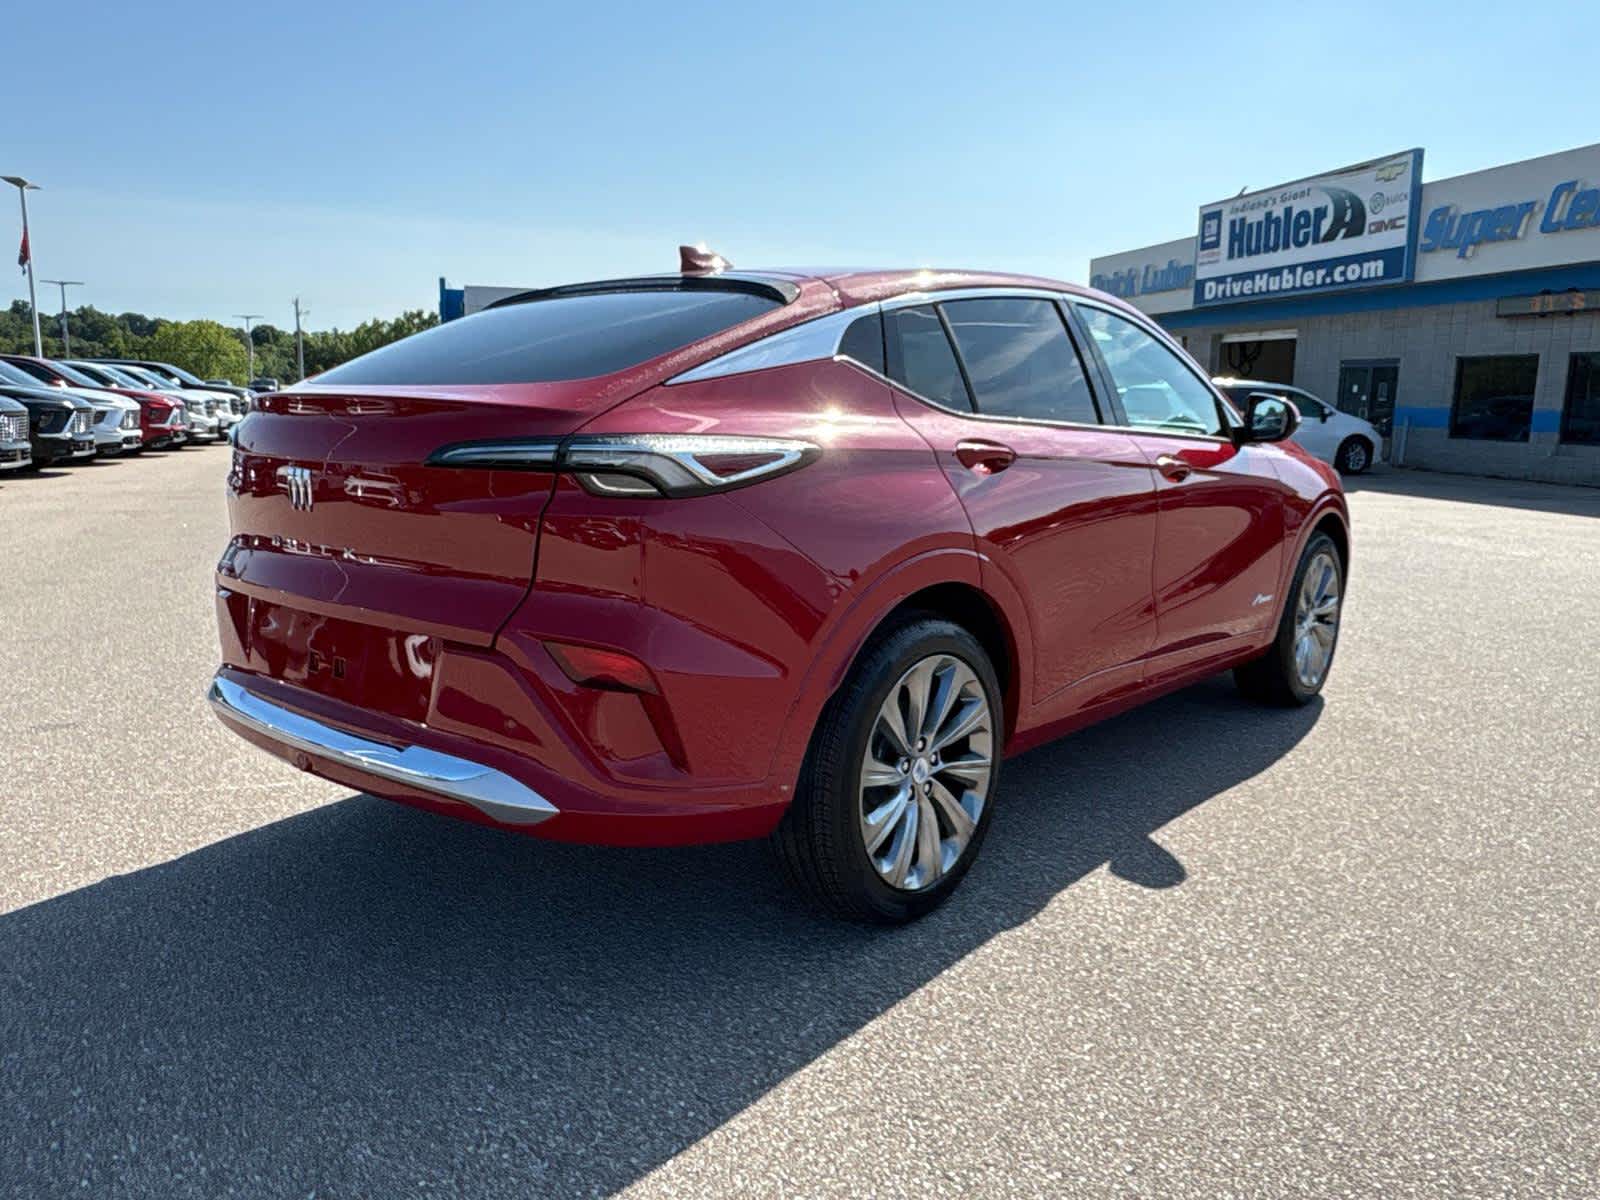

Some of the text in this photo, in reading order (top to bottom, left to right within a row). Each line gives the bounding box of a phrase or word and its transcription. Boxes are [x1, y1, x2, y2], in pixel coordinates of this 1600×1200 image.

[1227, 203, 1328, 260] Hubler
[1368, 215, 1406, 235] GMC
[1420, 180, 1600, 259] Super Ce
[1204, 259, 1385, 300] DriveHubler.com
